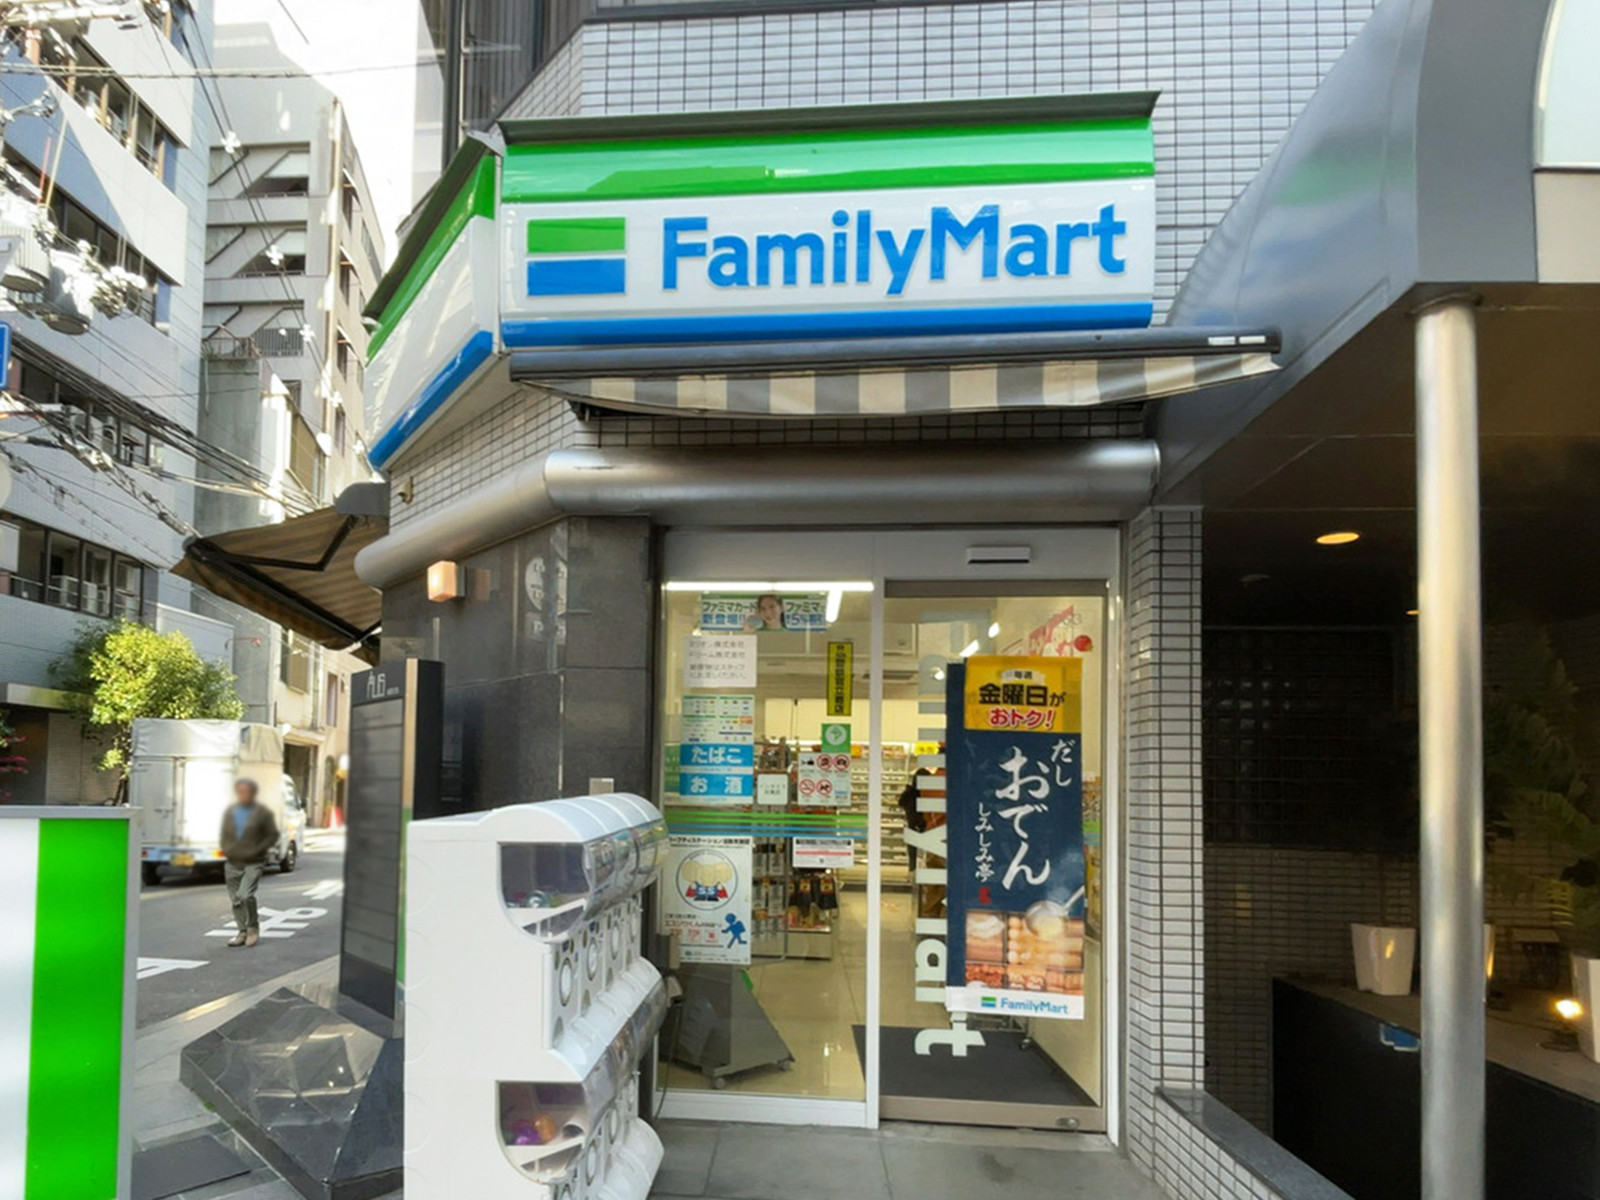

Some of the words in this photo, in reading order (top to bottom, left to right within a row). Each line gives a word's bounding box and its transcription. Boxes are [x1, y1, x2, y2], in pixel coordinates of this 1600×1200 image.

[662, 204, 1127, 295] FamilyMart
[979, 683, 1067, 707] 金曜日が
[691, 746, 742, 764] たばこ
[1051, 739, 1077, 787] だし
[974, 802, 995, 882] しみしみ亭
[995, 746, 1051, 891] おでん
[1000, 997, 1069, 1014] FamilyMart
